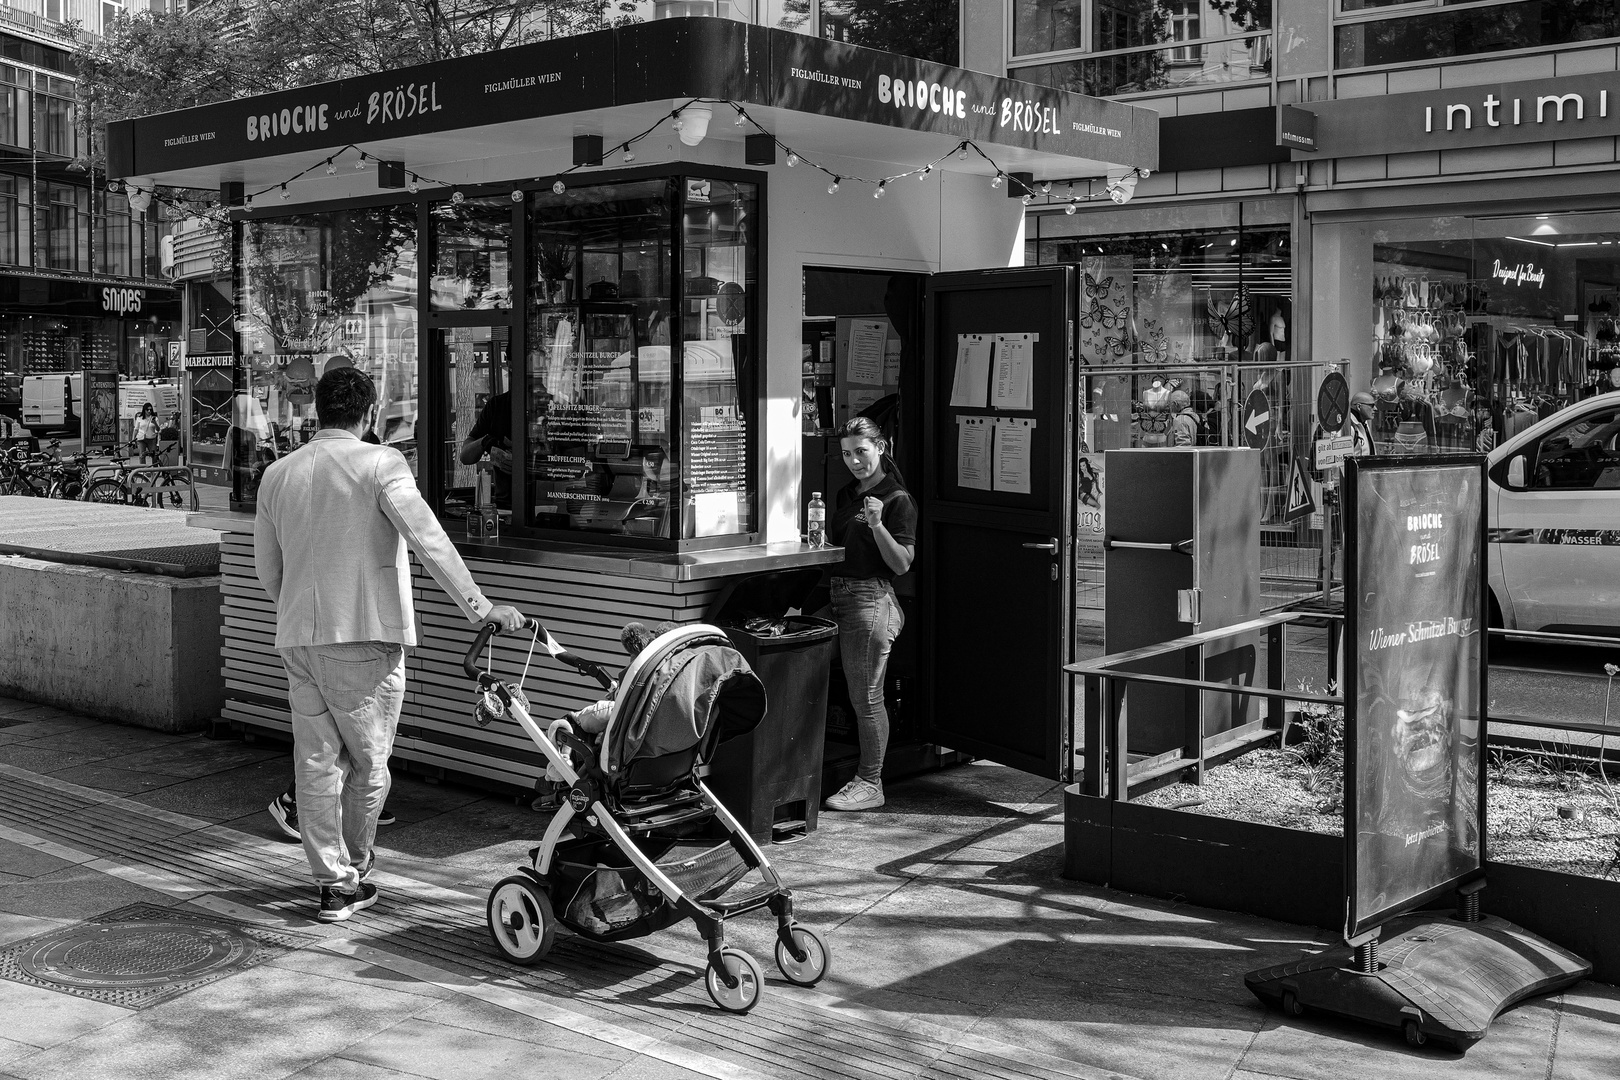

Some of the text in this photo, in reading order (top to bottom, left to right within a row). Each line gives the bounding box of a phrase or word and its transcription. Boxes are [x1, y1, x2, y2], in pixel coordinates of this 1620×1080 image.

[484, 72, 562, 94] FIGLMÜLLER WIEN
[791, 67, 862, 90] FIGLMÜLLER WIEN
[246, 81, 442, 142] BRIOCHE und BRÖSEL
[878, 74, 1061, 135] BRIOCHE und BRÖSEL
[164, 131, 216, 147] FIGLMÜLLER WIEN
[1072, 122, 1122, 138] FIGLMÜLLER WIEN
[1526, 262, 1545, 289] Beauty
[103, 286, 141, 317] snipes
[547, 454, 586, 464] TRÜFFELCHIPS
[547, 491, 602, 502] MANNERSCHNITTEN
[1406, 512, 1443, 532] BRIOCHE
[1562, 536, 1603, 545] WASSER
[1409, 542, 1441, 565] BRÖSEL
[1369, 627, 1407, 651] Wiener
[1407, 616, 1447, 643] Schnitzel
[1404, 832, 1419, 848] Jetzt
